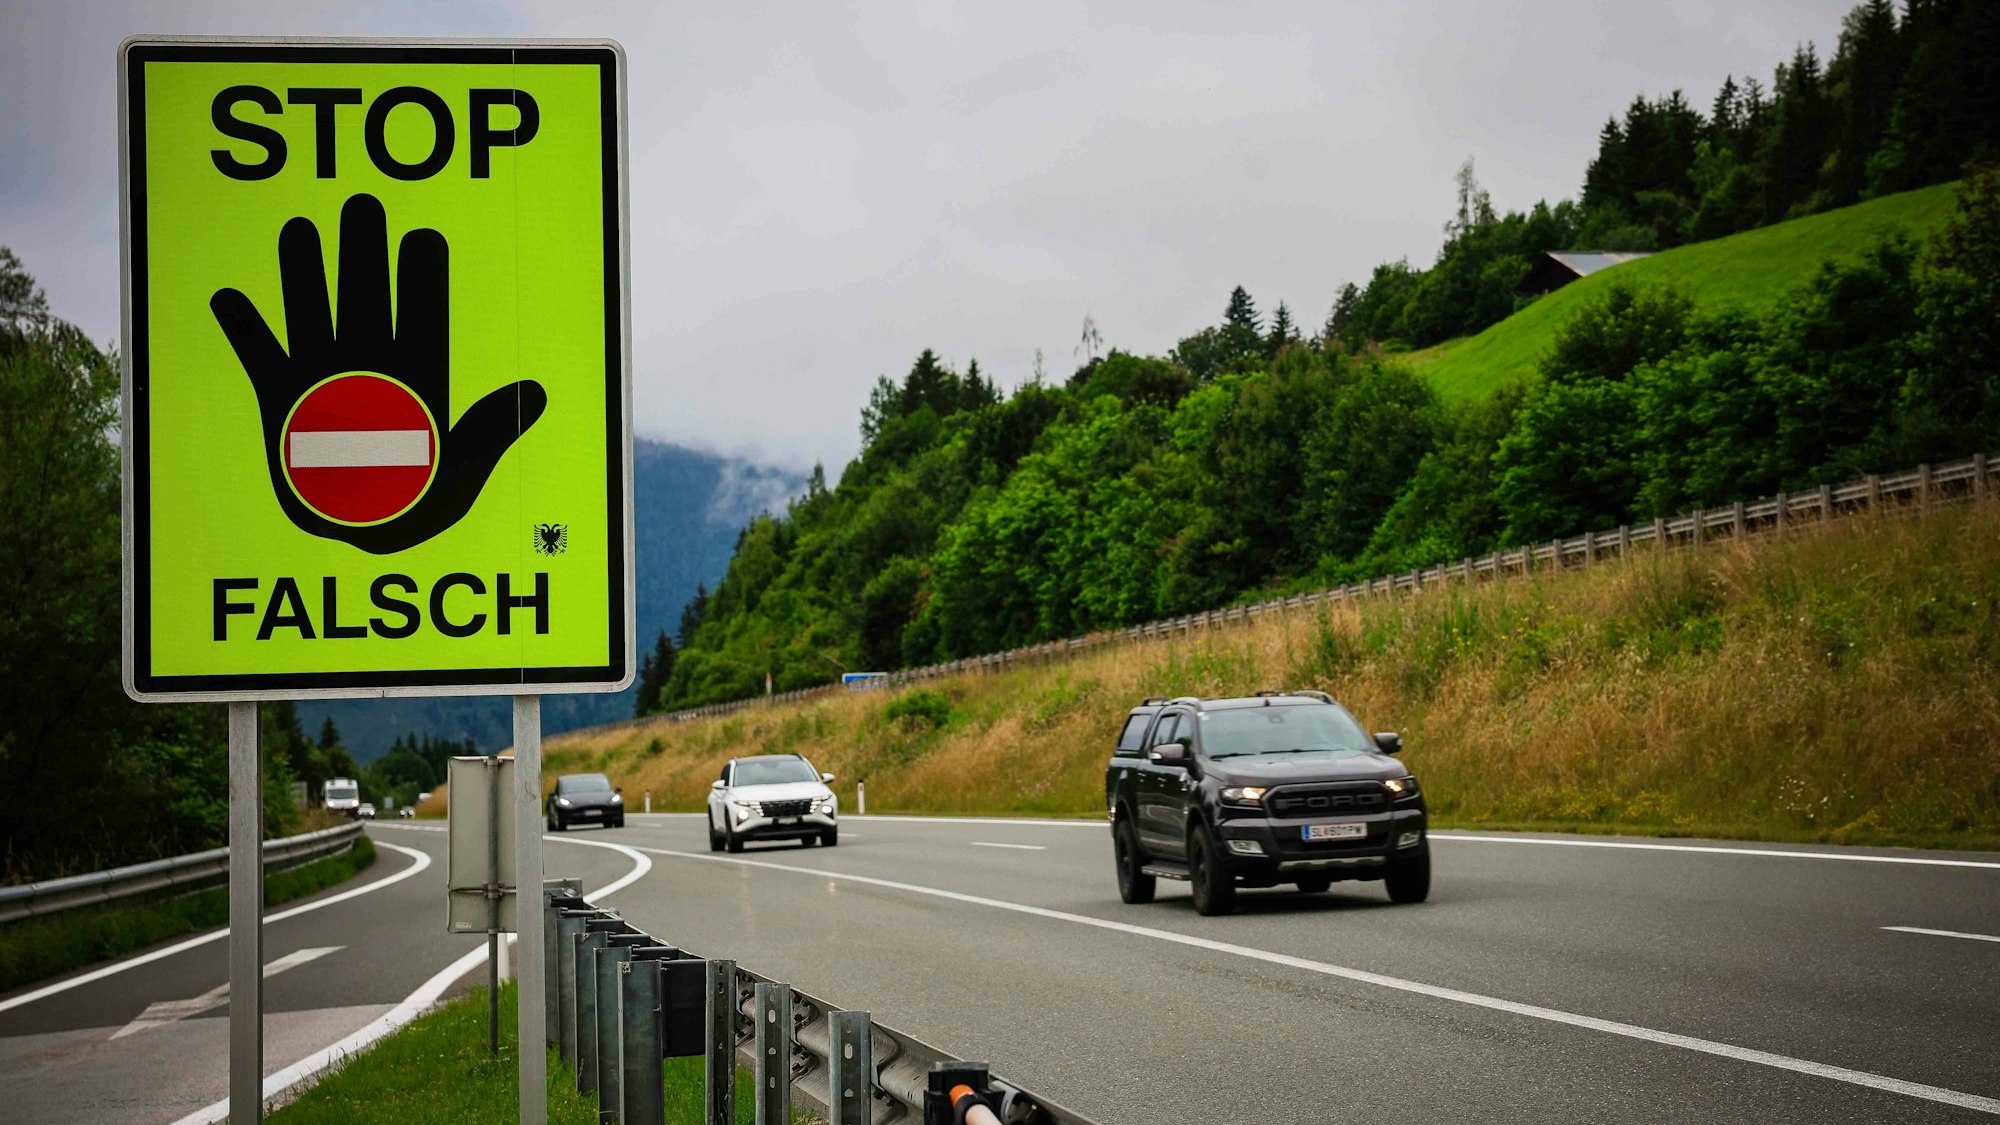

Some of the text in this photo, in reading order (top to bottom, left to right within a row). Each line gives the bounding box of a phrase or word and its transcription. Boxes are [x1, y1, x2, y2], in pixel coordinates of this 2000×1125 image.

[211, 85, 540, 181] STOP
[213, 573, 549, 641] FALSCH
[1275, 793, 1383, 809] FORD
